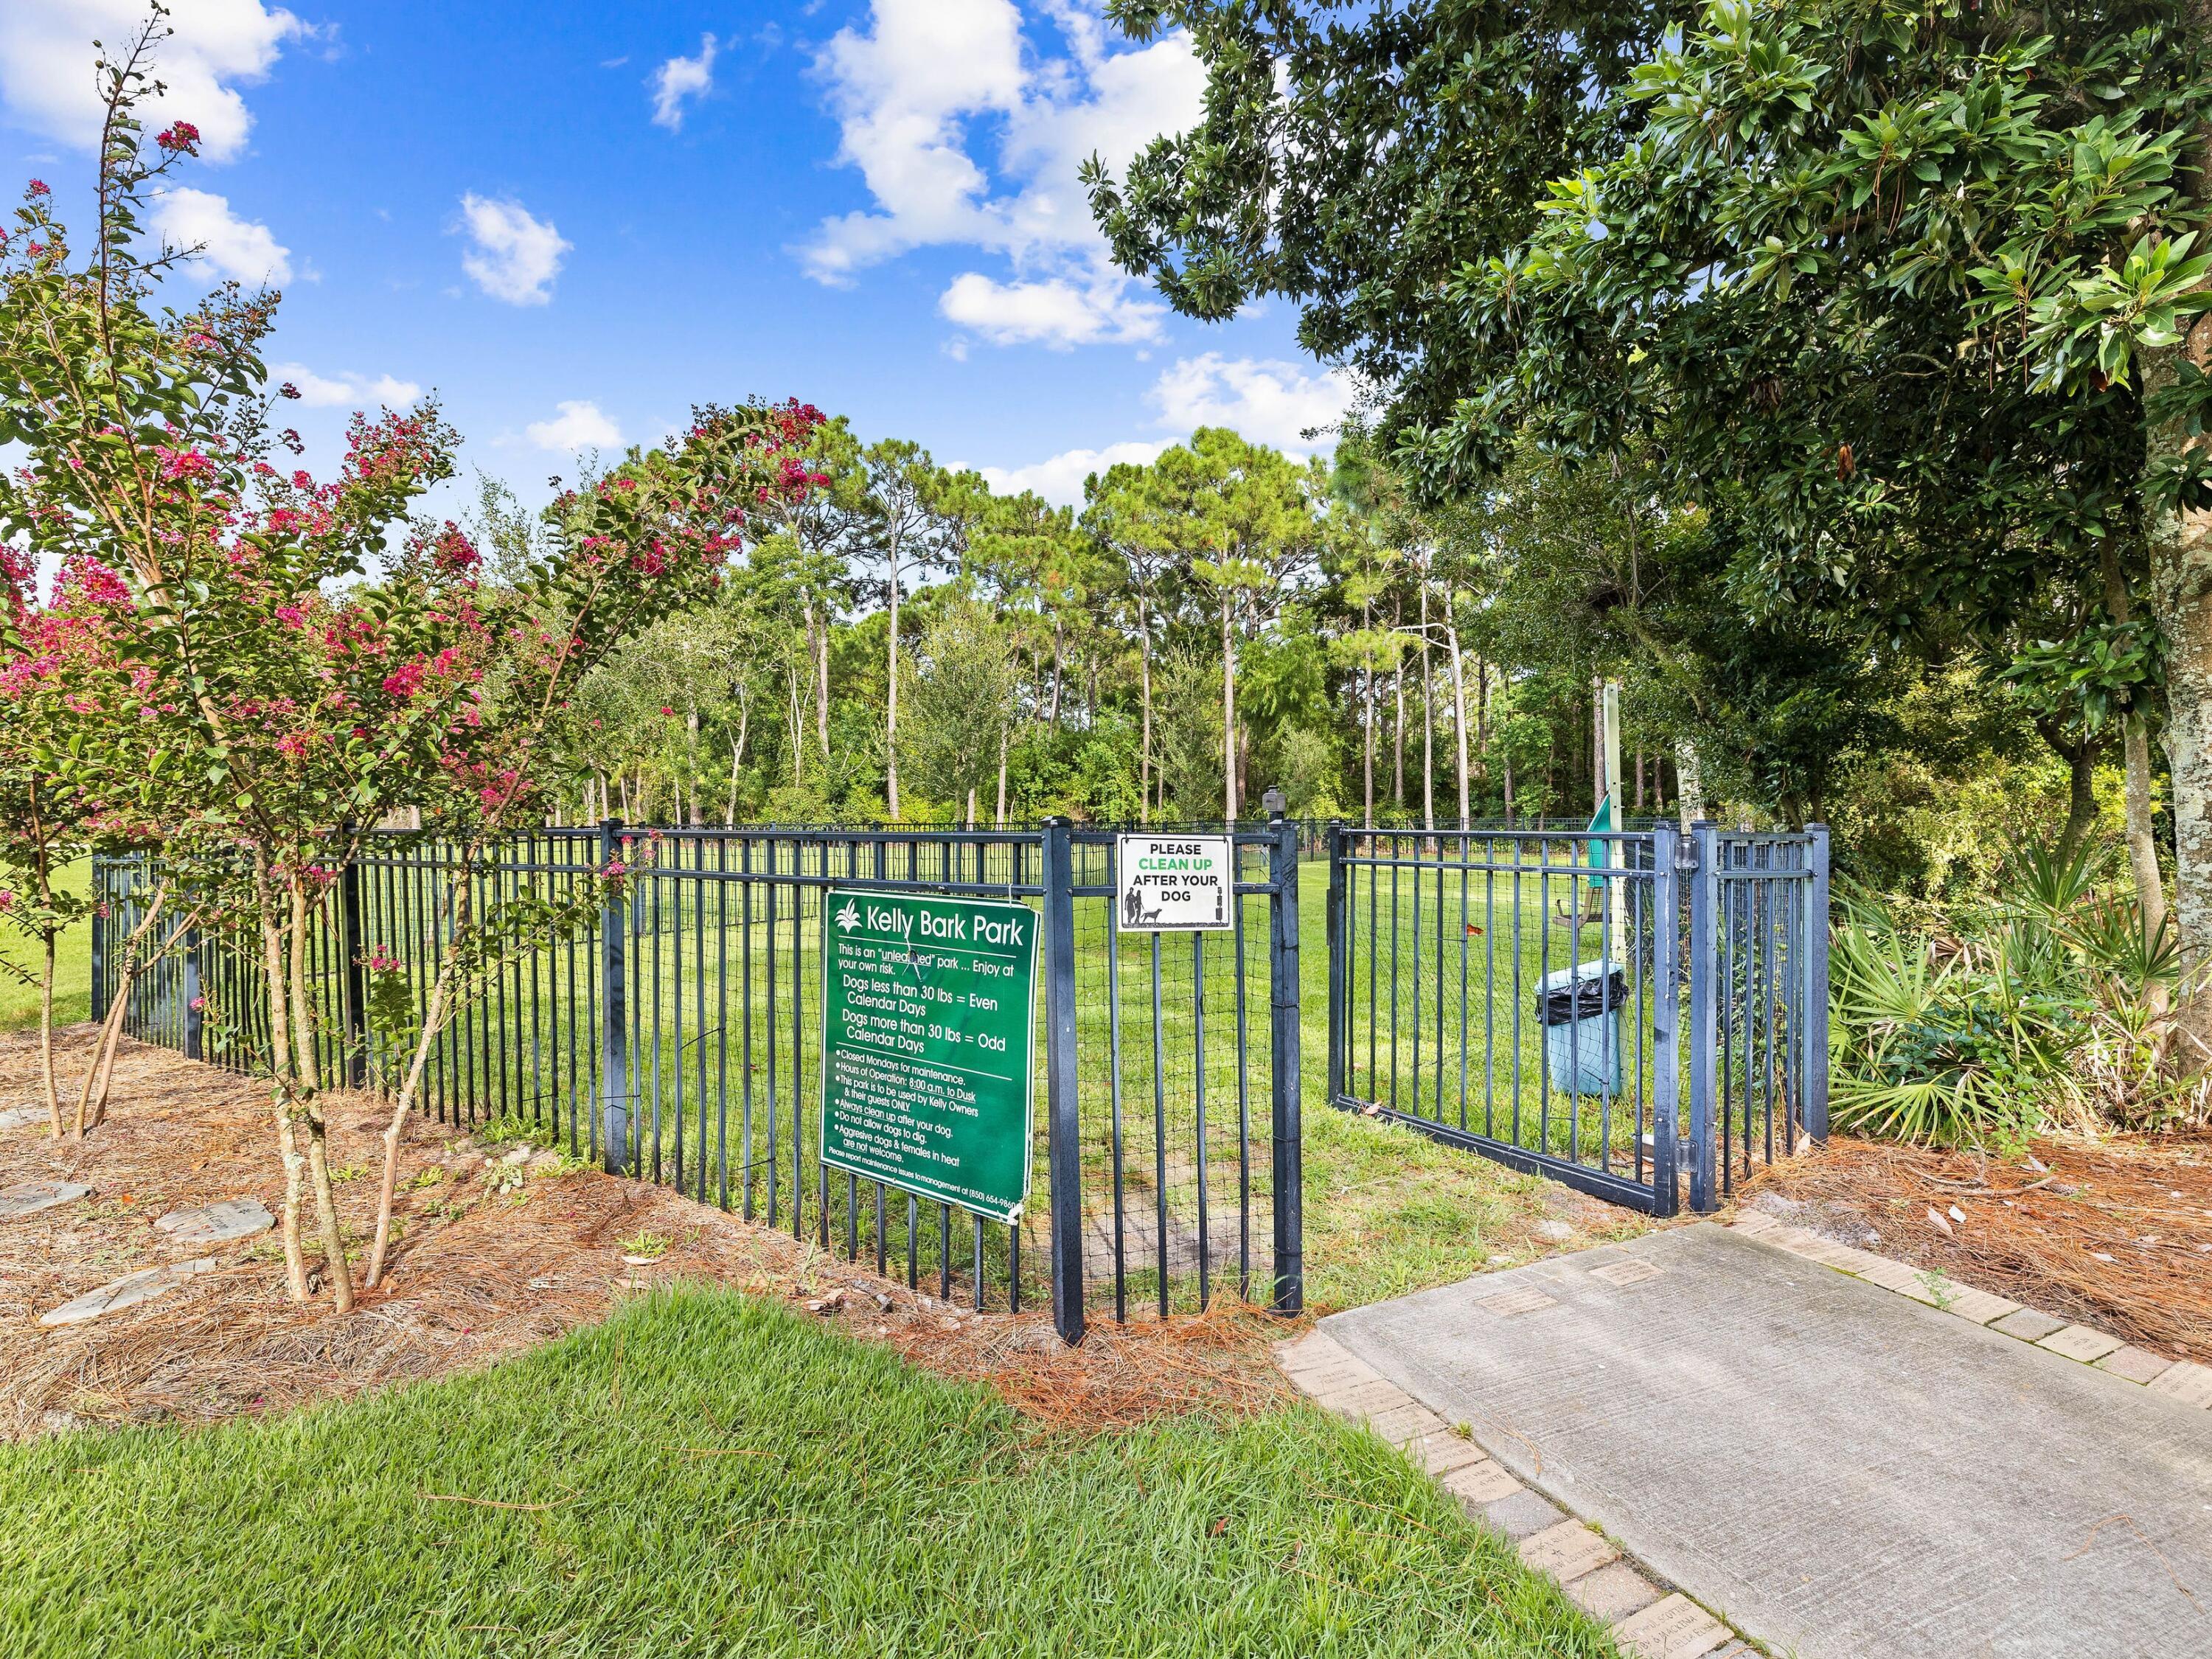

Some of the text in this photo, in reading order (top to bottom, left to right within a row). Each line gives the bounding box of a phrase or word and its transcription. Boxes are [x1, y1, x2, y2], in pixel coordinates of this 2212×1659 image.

[1138, 858, 1212, 870] CLEAN UP
[1150, 844, 1201, 855] PLEASE
[1133, 874, 1218, 886] AFTER YOUR
[1161, 891, 1191, 902] DOG
[868, 905, 1023, 946] Kelly Bark Park
[838, 943, 853, 956] This
[855, 945, 861, 956] is
[863, 949, 875, 958] an
[937, 957, 959, 969] park
[973, 961, 1001, 977] Enjoy
[1003, 964, 1014, 977] at
[838, 959, 895, 975] your own risk.
[844, 974, 869, 990] Dogs
[872, 978, 889, 993] less
[893, 981, 917, 998] than
[921, 985, 934, 1000] 30
[937, 987, 953, 1004] lbs
[970, 994, 998, 1011] Even
[847, 992, 926, 1017] Calendar Days
[843, 1009, 868, 1026] Dogs
[871, 1016, 897, 1030] more
[900, 1017, 925, 1036] than
[928, 1022, 942, 1038] 30
[945, 1026, 961, 1043] lbs
[978, 1033, 1005, 1052] Odd
[846, 1026, 925, 1054] Calendar Days
[841, 1050, 966, 1086] Closed Mondays for maintenance.
[841, 1062, 975, 1102] Hours of Operation: 8:00 a.m. to Dusk
[841, 1075, 978, 1117] This park is to be used by Kelly Owners
[844, 1088, 911, 1112] & their guests ONLY.
[840, 1099, 953, 1138] Always clean up after your dog.
[840, 1110, 927, 1144] Do not allow dogs to dig.
[839, 1124, 959, 1166] Aggresive dogs & females in heat
[844, 1139, 904, 1163] are not welcome.
[829, 1147, 844, 1158] Please
[846, 1153, 860, 1164] report
[862, 1158, 897, 1175] maintenance
[899, 1169, 913, 1178] issues
[915, 1173, 922, 1181] to
[921, 1175, 960, 1194] management
[961, 1186, 968, 1194] at
[969, 1189, 984, 1202] (850)
[1655, 1601, 1694, 1623] SCOTTIES
